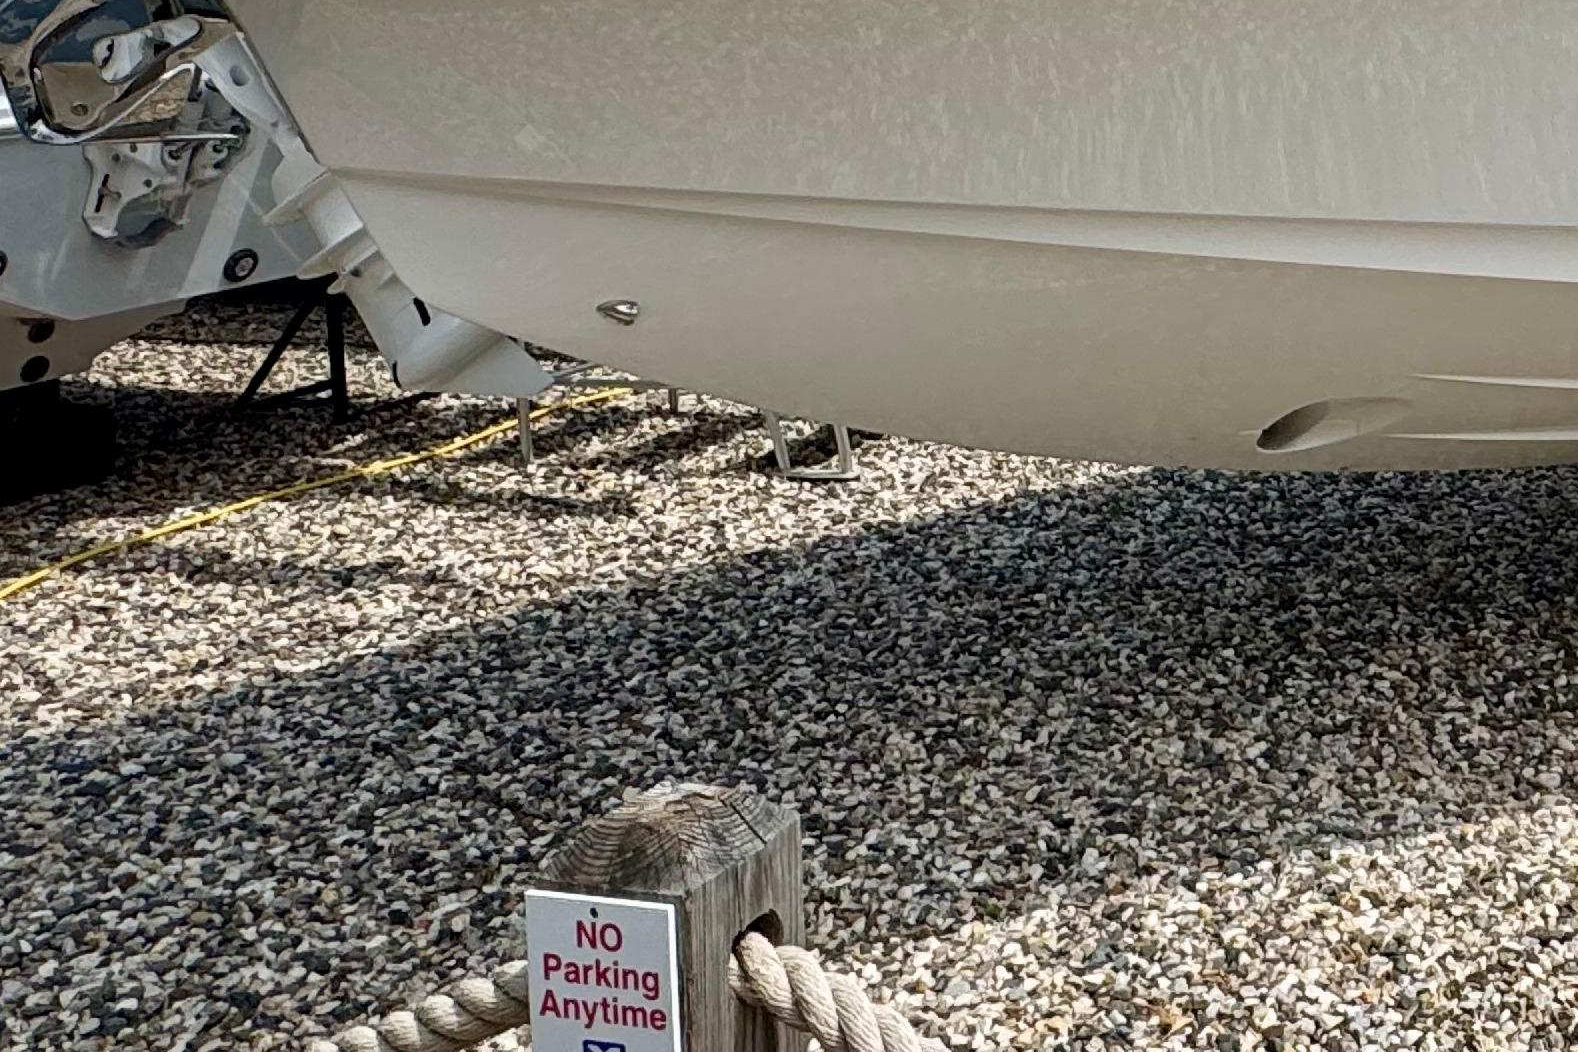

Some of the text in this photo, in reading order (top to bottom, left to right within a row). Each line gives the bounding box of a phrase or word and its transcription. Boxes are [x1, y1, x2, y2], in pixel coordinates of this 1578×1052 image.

[576, 920, 623, 953] NO
[543, 953, 660, 1001] Parking
[539, 989, 667, 1031] Anytime
